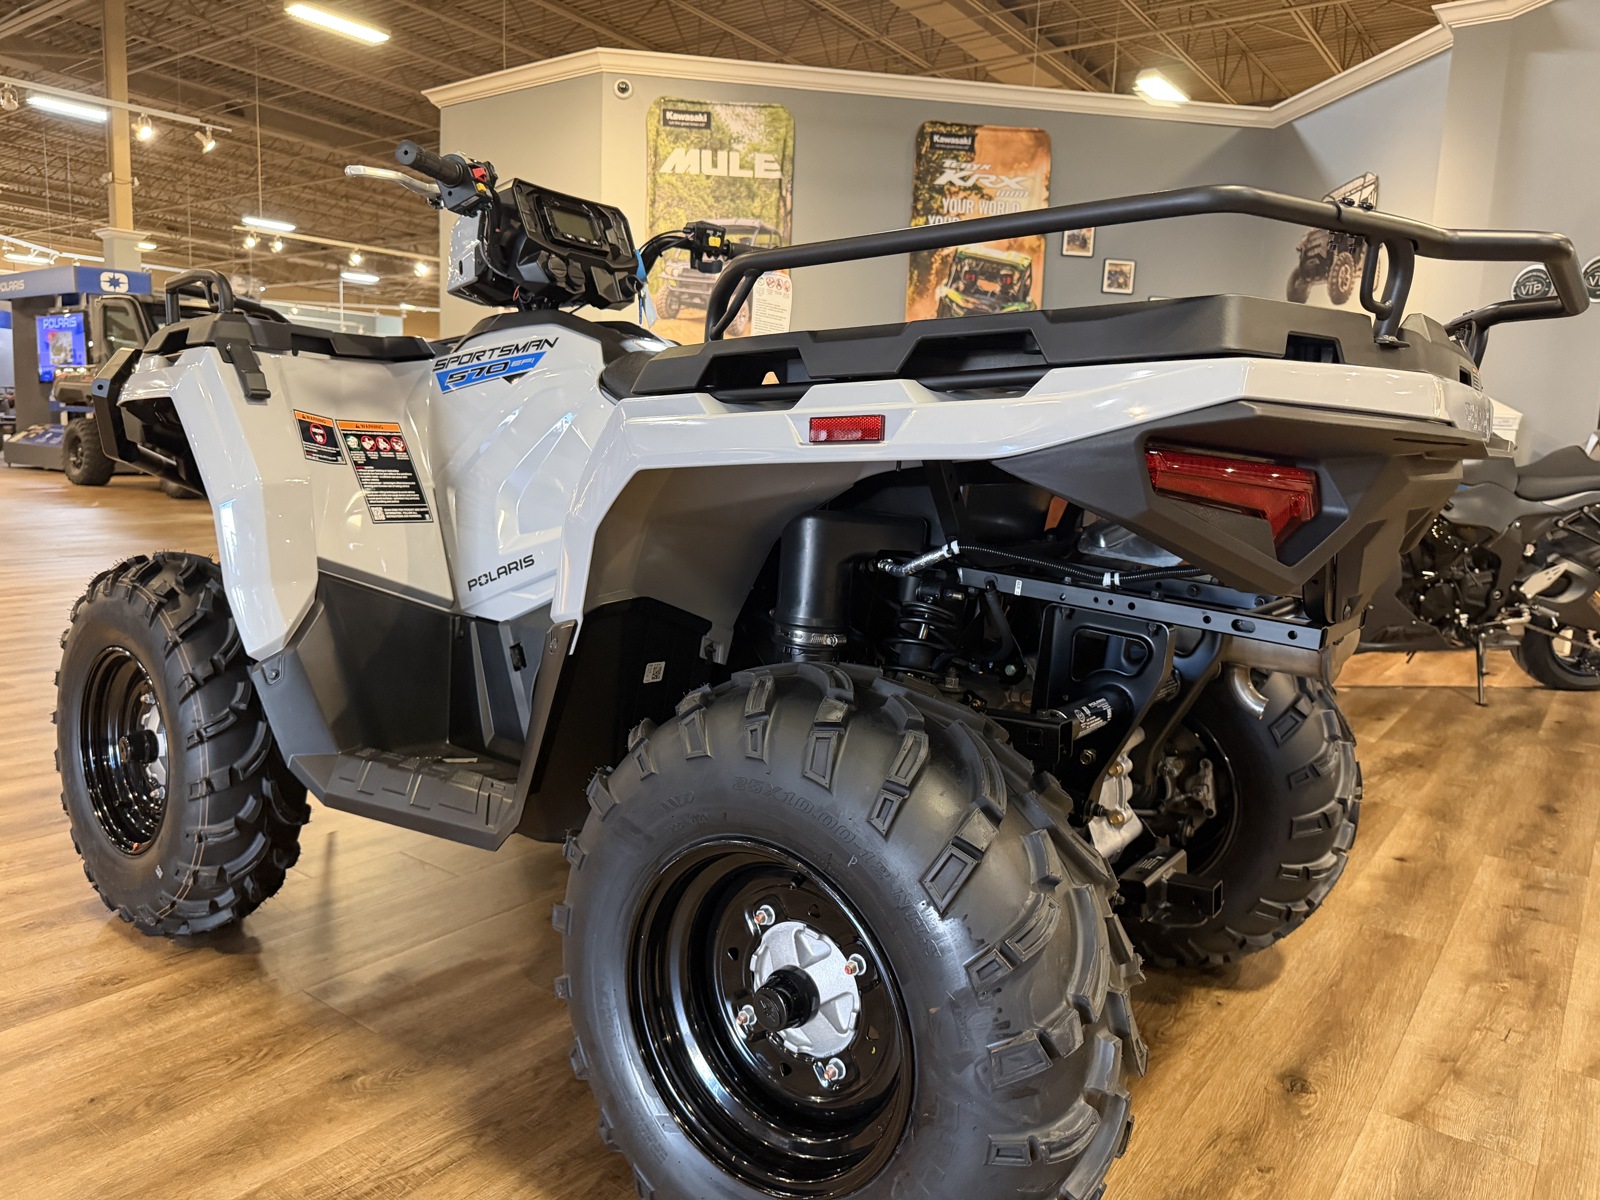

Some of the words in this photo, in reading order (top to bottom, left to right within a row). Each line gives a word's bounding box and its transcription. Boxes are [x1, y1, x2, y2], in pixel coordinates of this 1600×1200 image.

[665, 110, 708, 122] Kawasaki
[932, 134, 972, 146] Kawasaki
[660, 147, 782, 178] MULE
[933, 169, 1027, 190] KRX
[941, 197, 975, 214] YOUR
[979, 200, 1020, 215] WORLD
[0, 280, 25, 292] OLARIS
[1520, 283, 1542, 296] VIP
[43, 316, 77, 329] POLARIS
[432, 337, 560, 372] SPORTSMAN
[445, 360, 510, 386] 570
[467, 554, 535, 592] POLARIS
